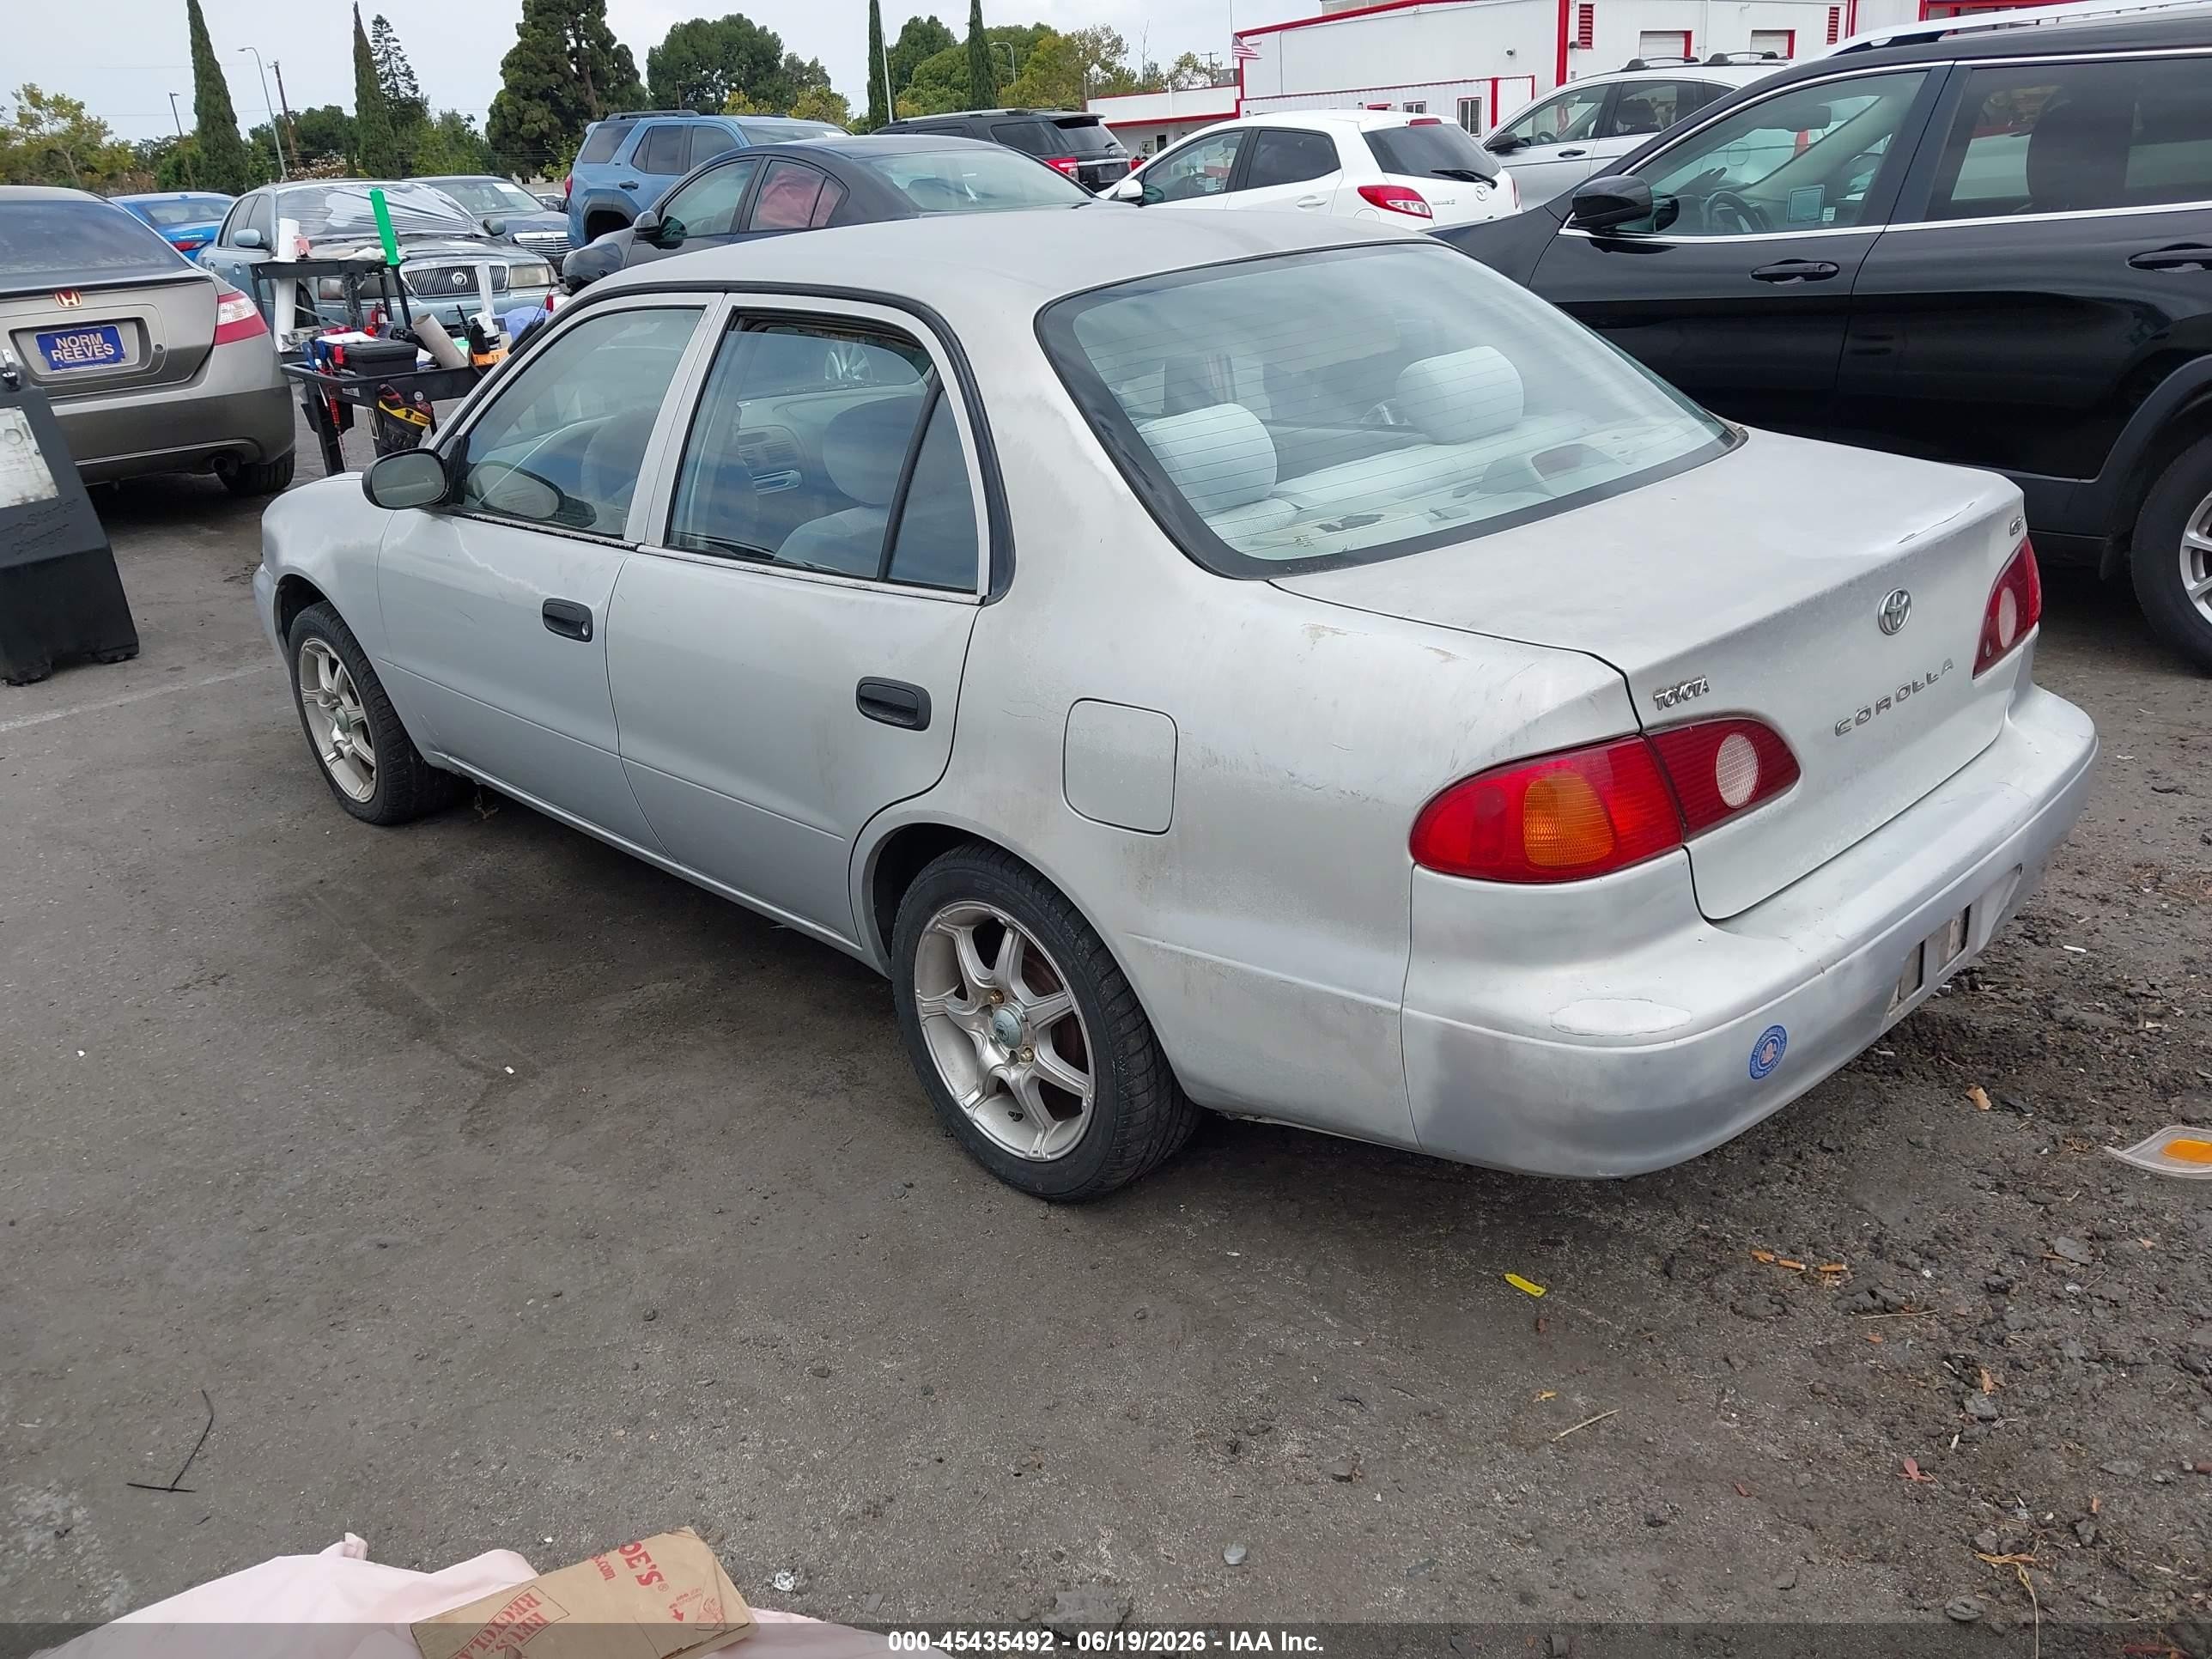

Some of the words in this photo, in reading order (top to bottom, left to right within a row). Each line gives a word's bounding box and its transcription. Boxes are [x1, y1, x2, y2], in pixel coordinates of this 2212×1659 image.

[51, 343, 115, 362] REEVES
[55, 332, 104, 349] NORM
[1653, 676, 1710, 711] TOYOTA
[1835, 658, 1954, 737] COROLLA
